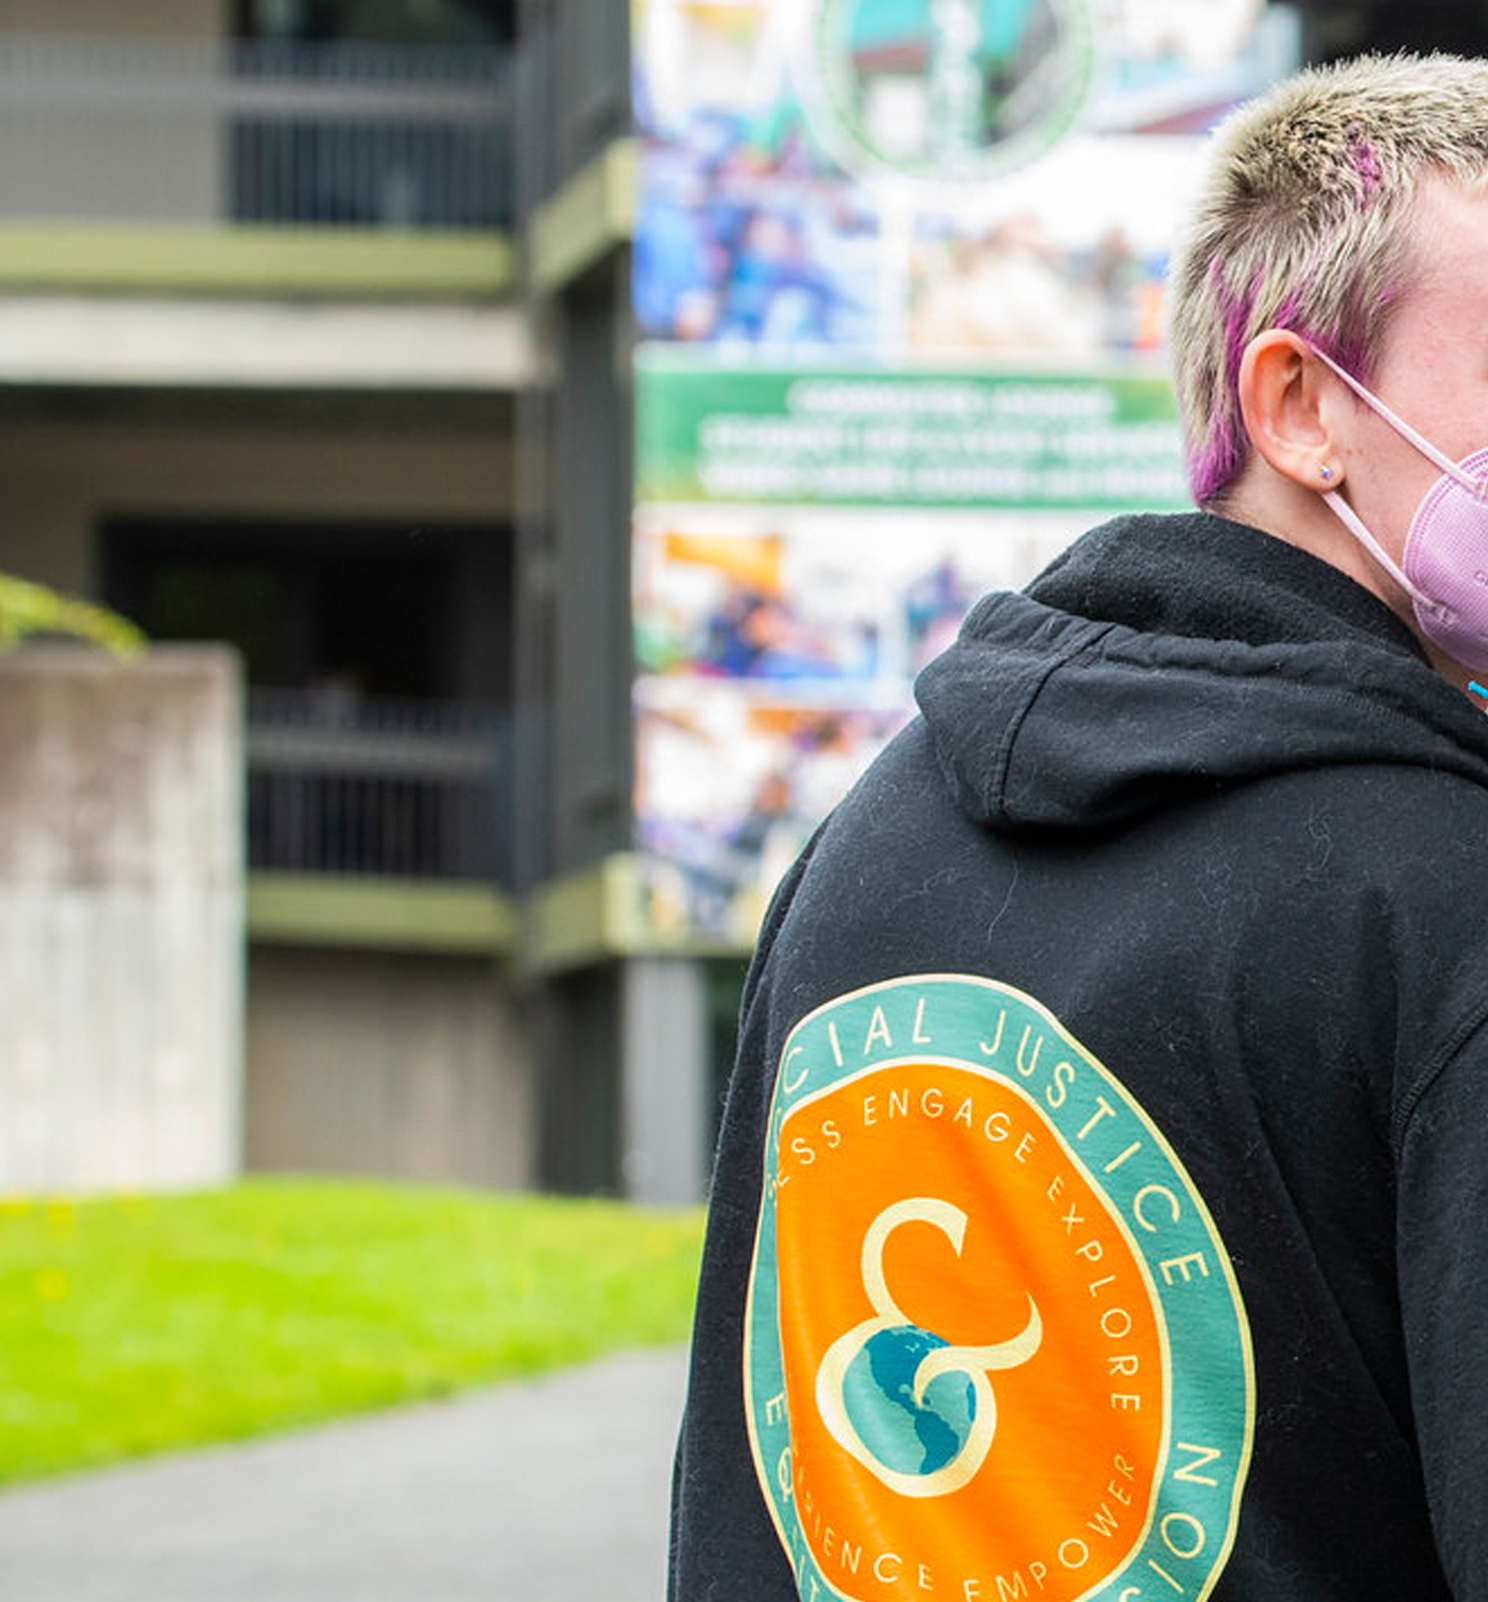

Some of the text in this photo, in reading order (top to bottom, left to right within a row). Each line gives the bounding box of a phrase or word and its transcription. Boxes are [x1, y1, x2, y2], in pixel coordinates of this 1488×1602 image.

[774, 997, 1209, 1286] CIAL JUSTICE
[863, 1088, 1036, 1163] ENGAGE
[1046, 1175, 1140, 1411] EXPLORE
